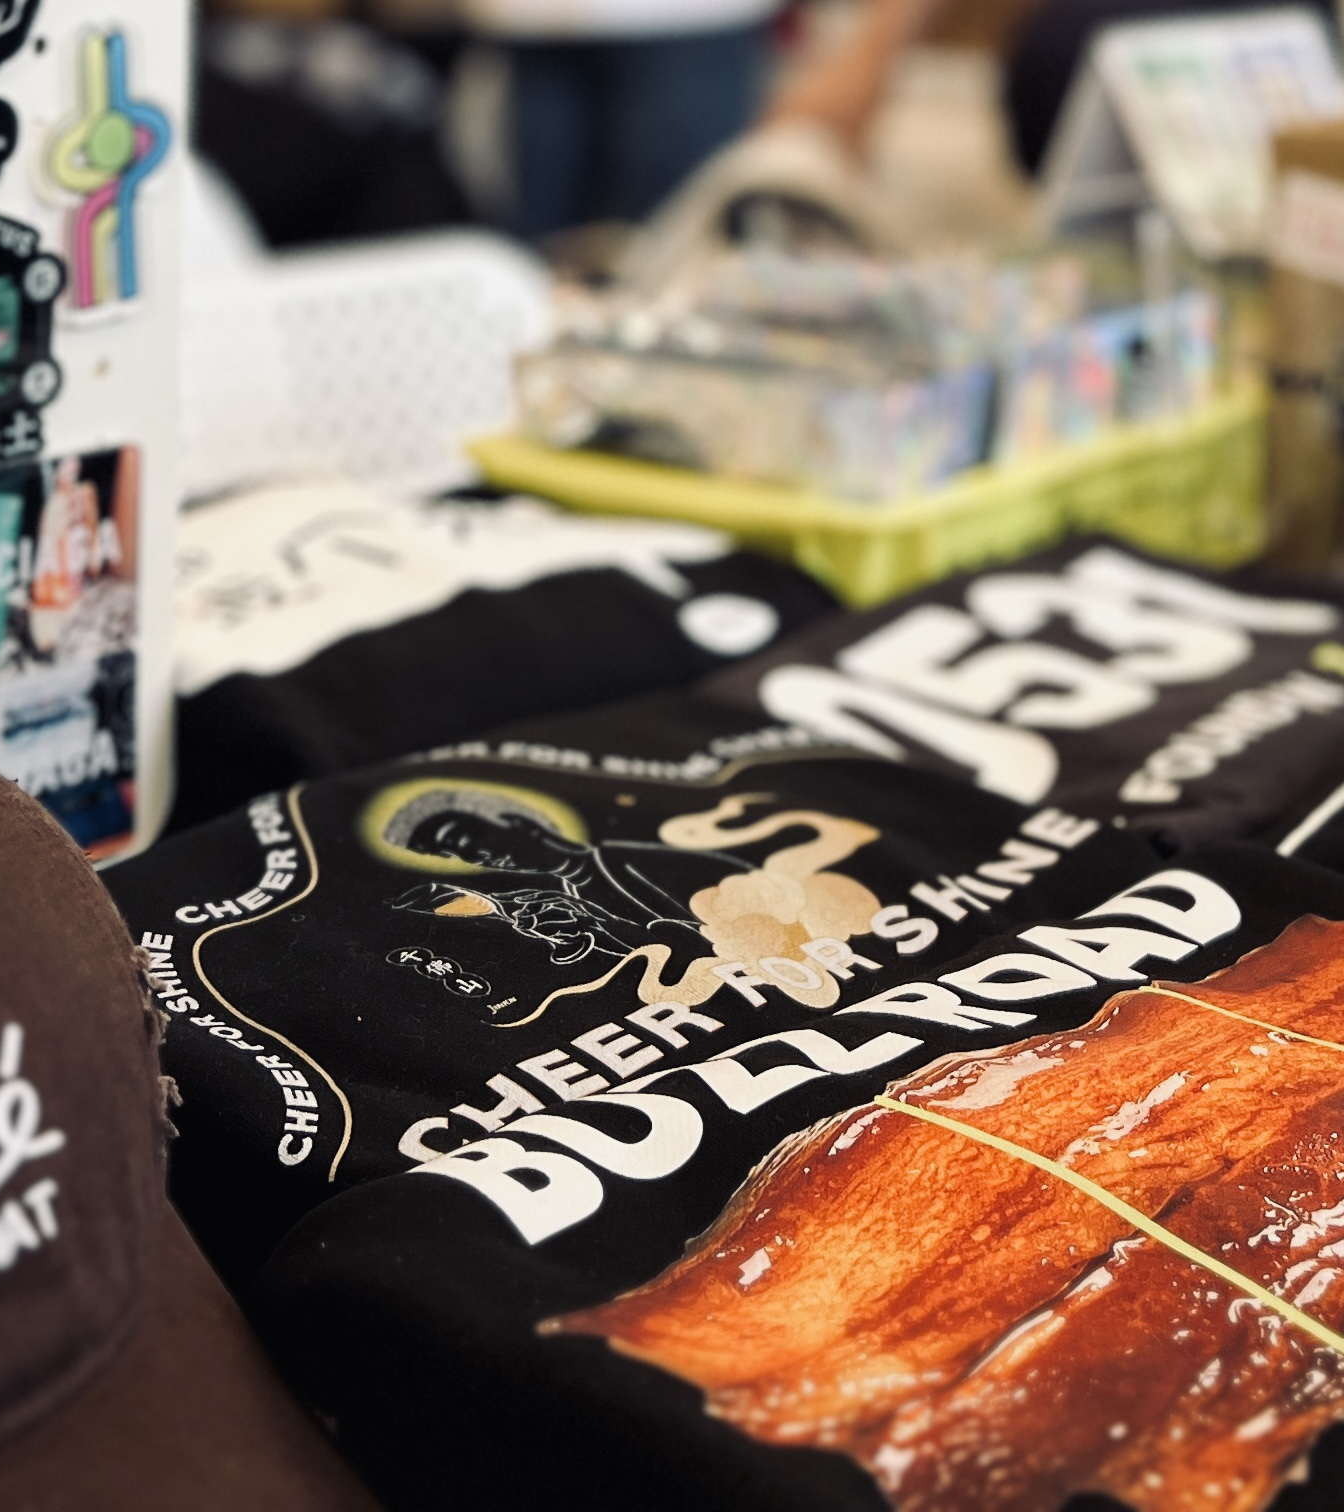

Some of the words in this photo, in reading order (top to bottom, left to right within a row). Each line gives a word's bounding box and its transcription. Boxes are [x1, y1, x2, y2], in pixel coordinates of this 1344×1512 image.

[759, 545, 1343, 806] 0531
[175, 847, 299, 925] CHEER
[140, 930, 200, 1014] SHINE
[398, 997, 726, 1164] CHEER
[710, 934, 883, 1009] FOR
[869, 805, 1102, 957] SHINE
[832, 869, 1242, 1031] ROAD
[189, 1013, 265, 1051] FOR
[277, 1055, 319, 1167] CHEER
